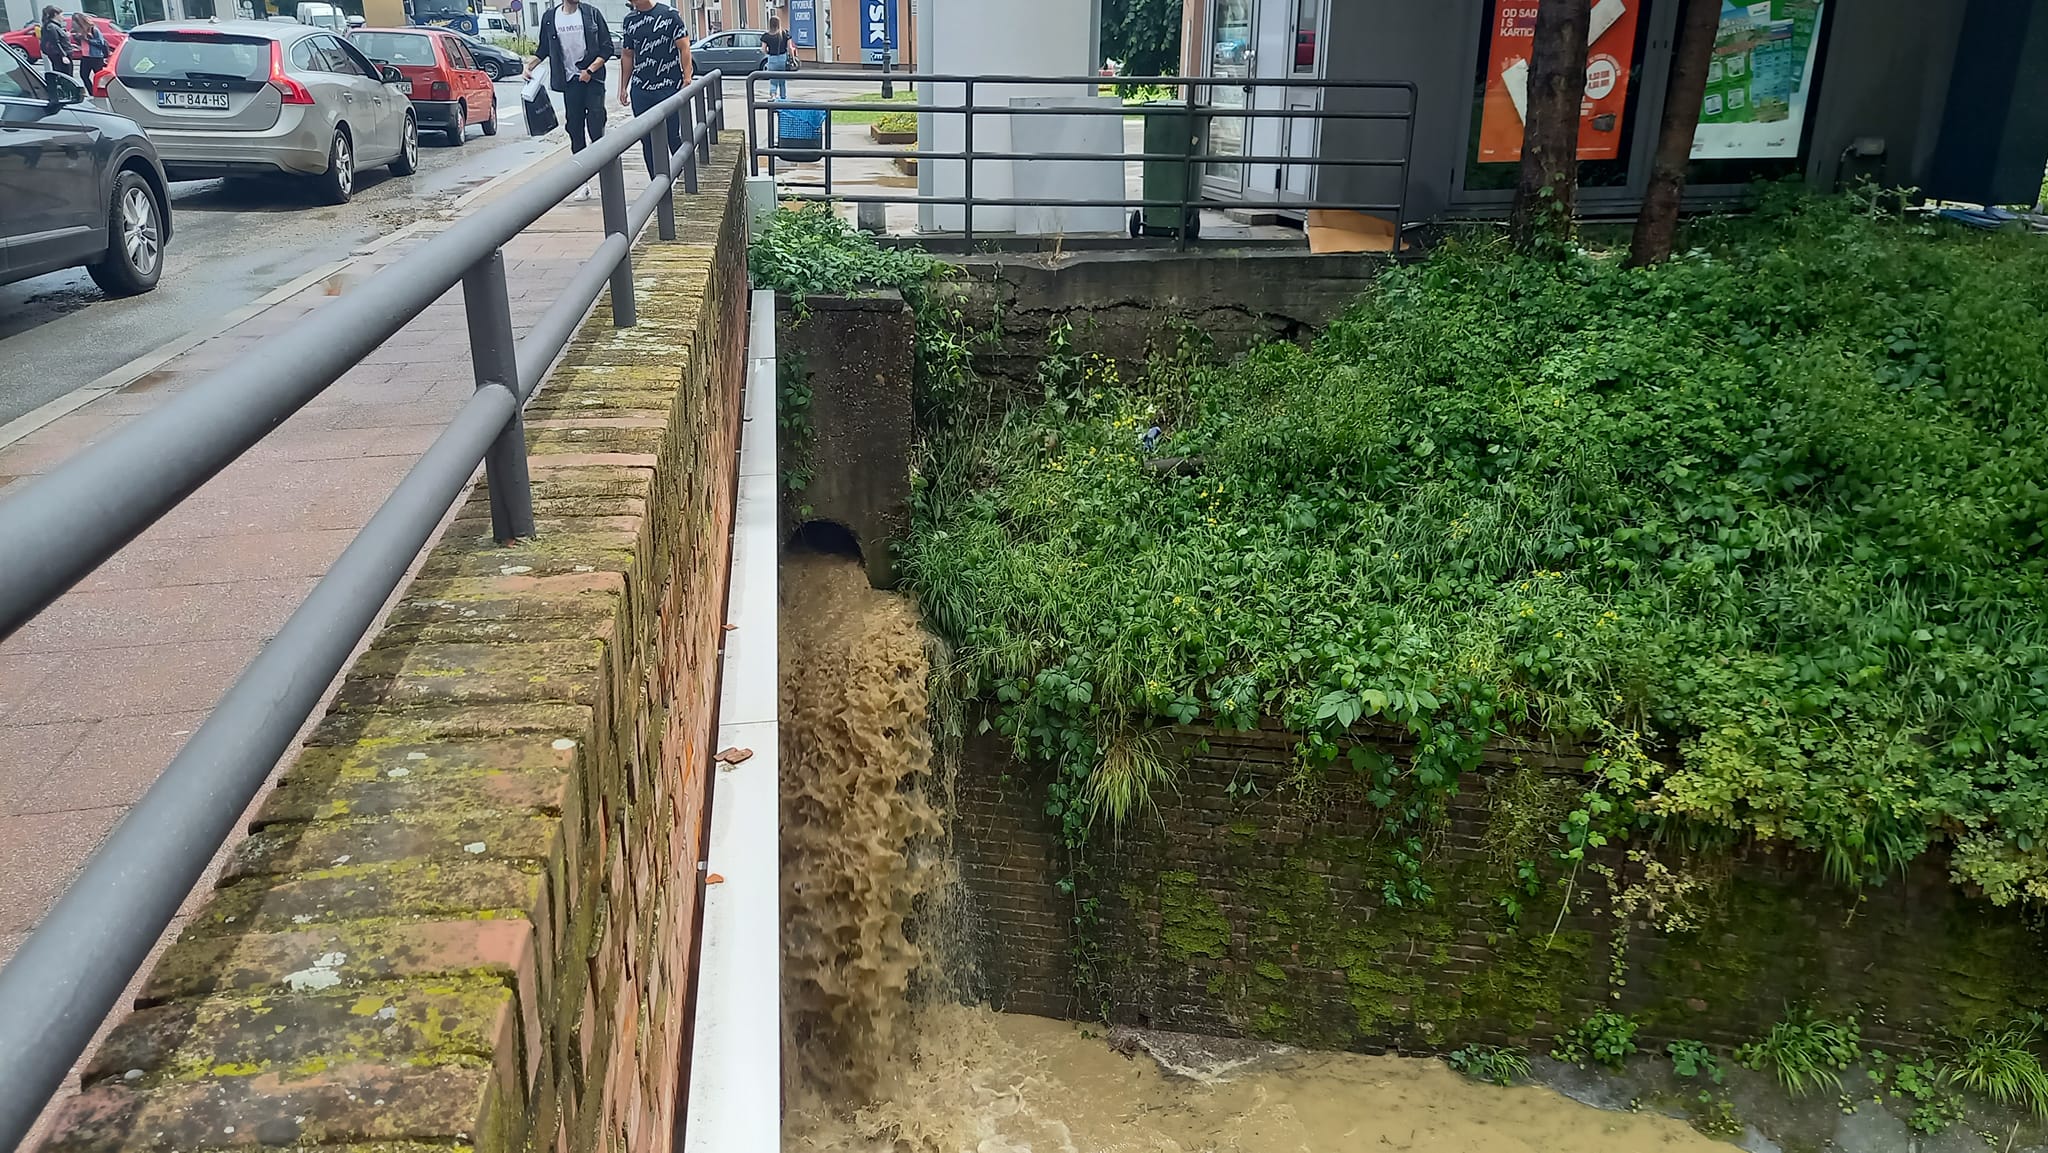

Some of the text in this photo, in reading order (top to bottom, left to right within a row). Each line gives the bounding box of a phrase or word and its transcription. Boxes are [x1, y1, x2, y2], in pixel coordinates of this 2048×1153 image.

[1502, 8, 1538, 18] OD SAD
[1506, 18, 1514, 28] S
[151, 80, 229, 88] VOLVO
[165, 93, 227, 106] KT 844-HS
